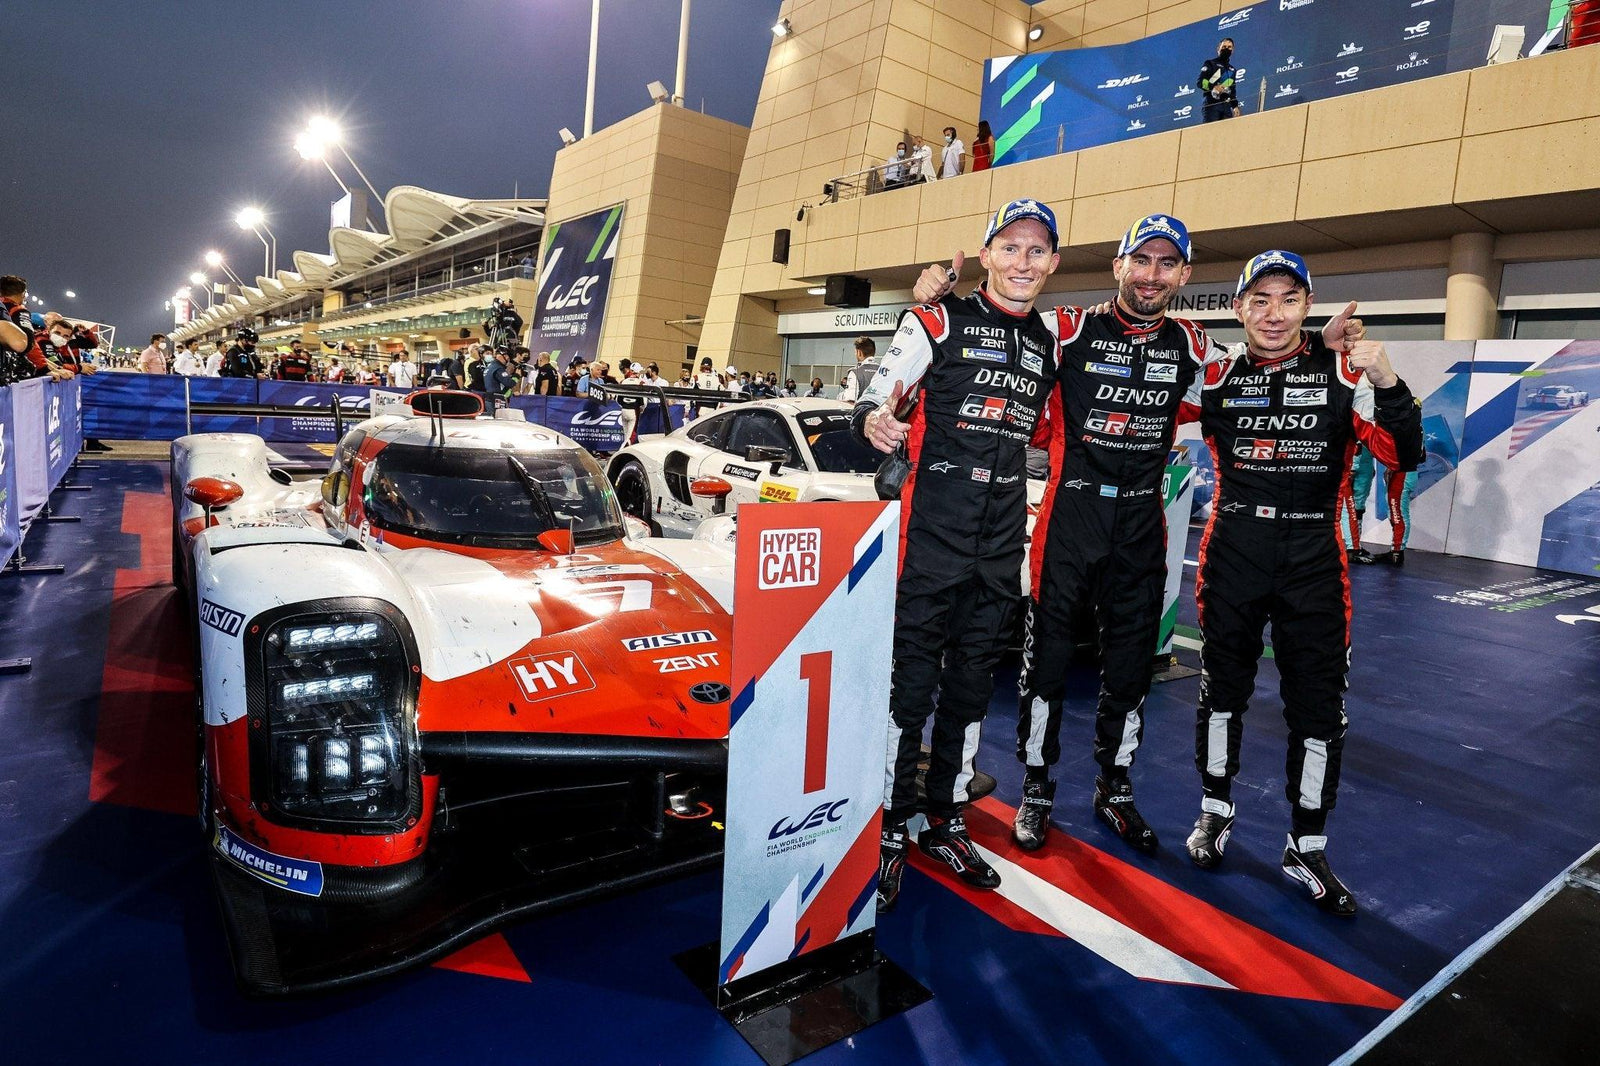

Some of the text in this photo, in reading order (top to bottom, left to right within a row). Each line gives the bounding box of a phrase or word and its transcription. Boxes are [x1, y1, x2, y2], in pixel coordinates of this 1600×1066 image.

[1218, 8, 1253, 25] WEC
[1276, 61, 1303, 73] ROLEX
[1396, 58, 1429, 71] ROLEX
[1103, 74, 1146, 88] DHL
[1127, 100, 1149, 110] ROLEX
[1006, 207, 1050, 221] MICHELIN
[1137, 225, 1181, 240] MICHELIN
[1252, 259, 1298, 273] MICHELIN
[546, 275, 599, 309] WEC
[835, 312, 899, 327] SCRUTINEERIN
[964, 326, 1005, 339] AISIN
[980, 339, 1007, 350] ZENT
[1091, 340, 1133, 353] AISIN
[975, 351, 1004, 359] MICHELIN
[1022, 353, 1043, 367] WEC
[1104, 353, 1133, 365] ZENT
[1147, 349, 1170, 359] Mobil
[1098, 366, 1127, 375] MICHELIN
[1148, 365, 1175, 375] WEC
[974, 368, 1037, 397] DENSO
[1228, 375, 1270, 386] AISIN
[1286, 373, 1328, 384] Mobil 1
[589, 386, 604, 401] BOSS
[1095, 384, 1169, 406] DENSO
[1241, 387, 1270, 396] ZENT
[1286, 389, 1325, 399] WEC
[571, 410, 623, 425] WE
[961, 403, 1002, 421] GR
[955, 421, 999, 434] RACING
[1086, 417, 1124, 435] GR
[1237, 414, 1318, 431] DENSO
[1129, 430, 1162, 439] Racing
[1082, 435, 1124, 449] RACING
[1278, 440, 1328, 448] TOYOTA
[1234, 446, 1273, 460] GR
[1276, 452, 1321, 461] Racing
[1234, 462, 1328, 473] RACING HYBRID
[765, 486, 794, 501] DHL
[360, 527, 368, 543] E
[763, 532, 817, 553] HYPER
[566, 565, 620, 573] WEC
[762, 553, 816, 585] CAR
[201, 600, 242, 634] AISIN
[629, 631, 712, 650] AISIN
[652, 652, 720, 674] ZENT
[515, 657, 578, 694] HY
[800, 650, 833, 794] 1
[768, 798, 850, 840] WEC
[779, 836, 803, 848] WORLD
[804, 825, 843, 840] ENDURANCE
[766, 839, 817, 858] CHAMPIONSHIP
[230, 843, 308, 882] MICHELIN
